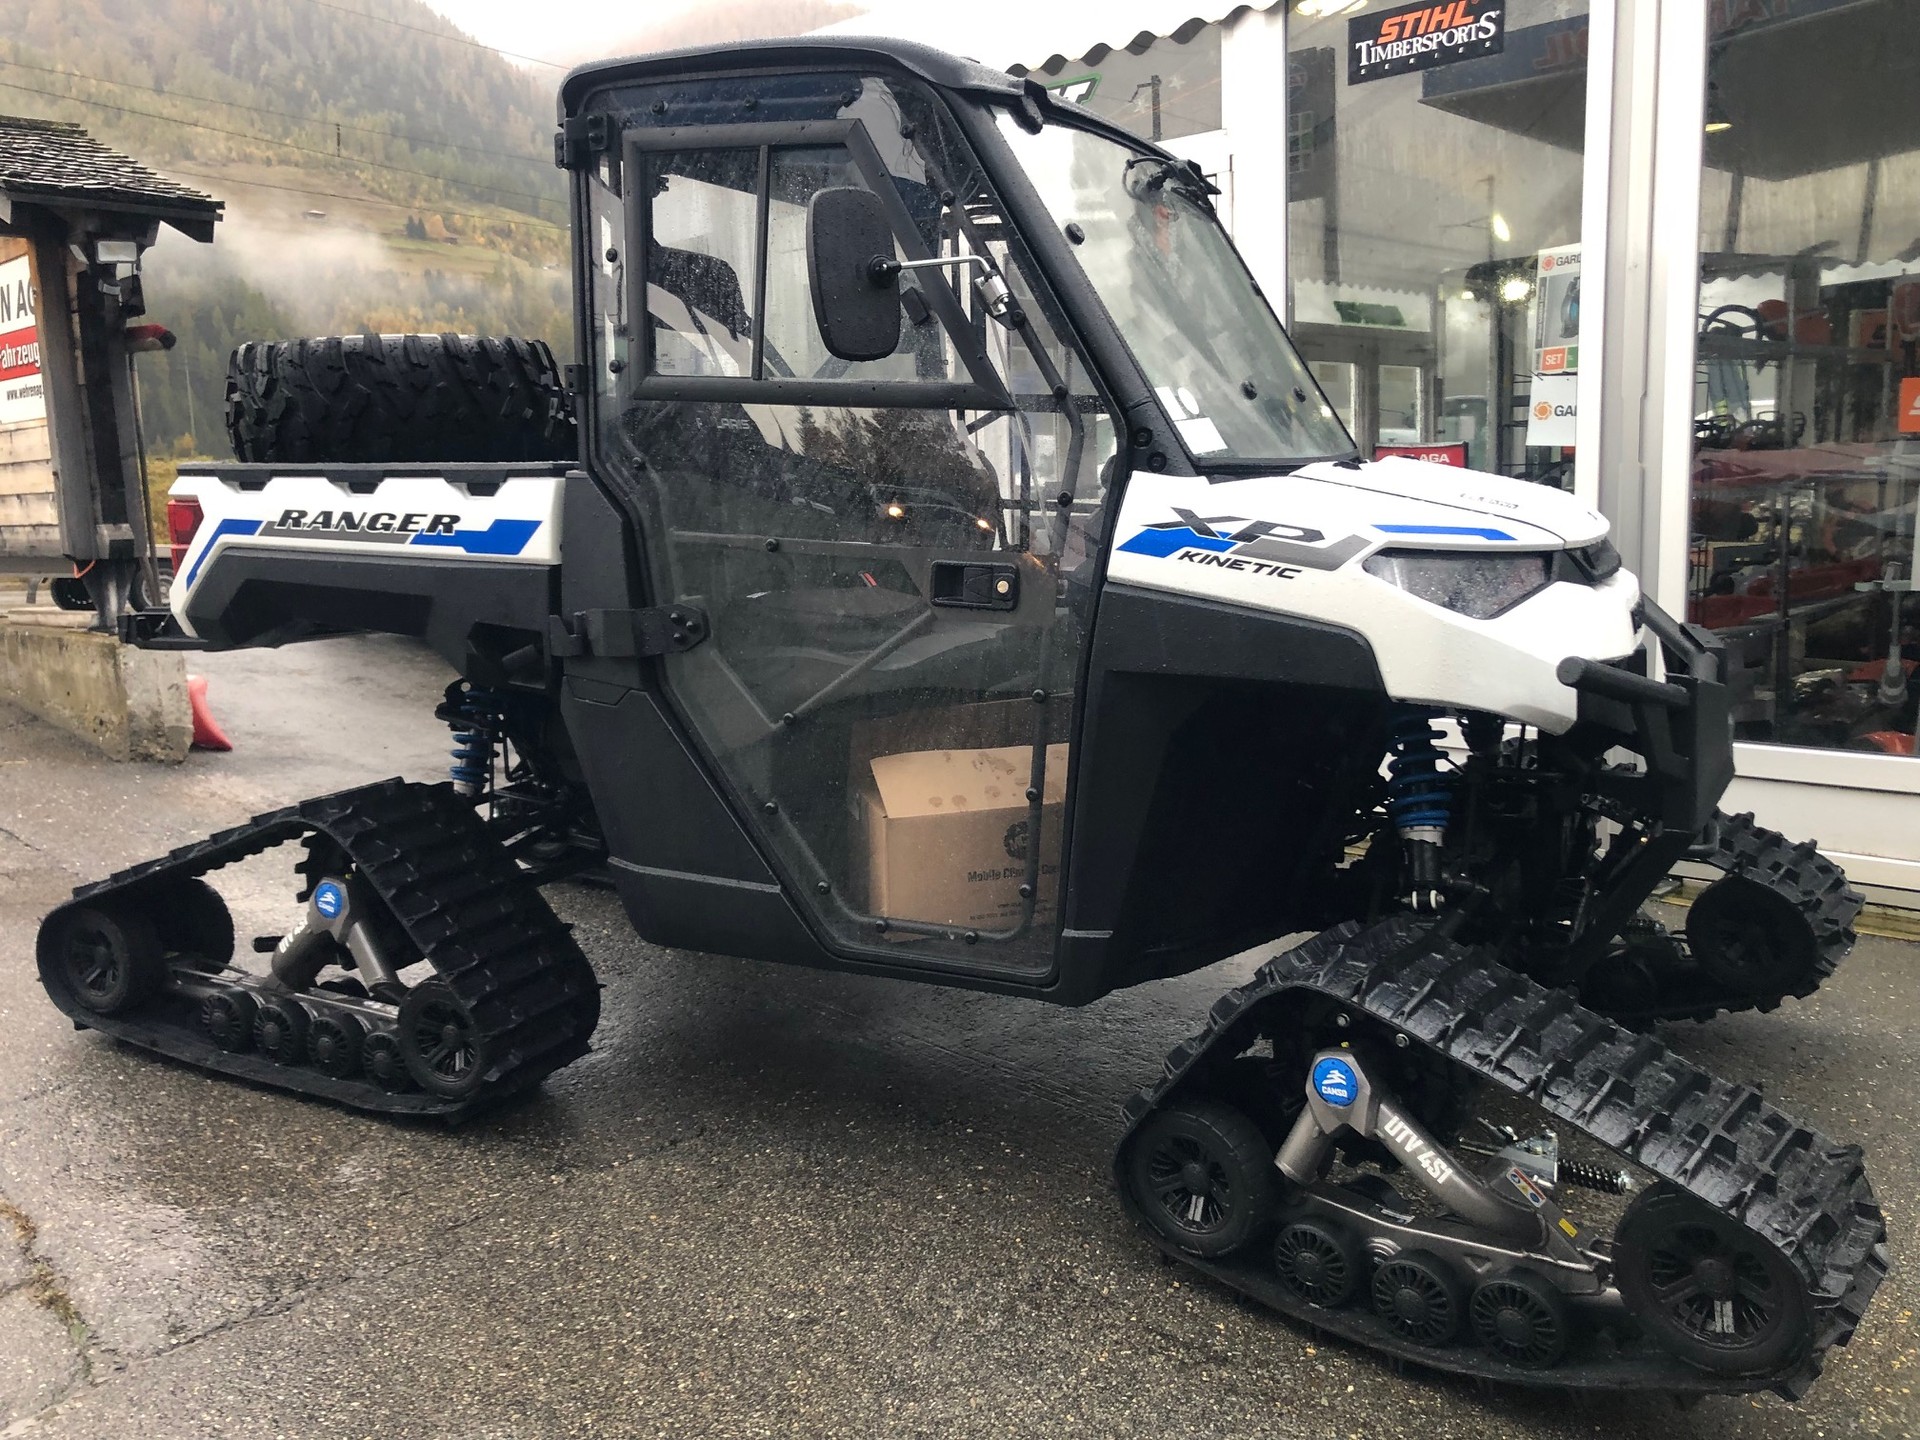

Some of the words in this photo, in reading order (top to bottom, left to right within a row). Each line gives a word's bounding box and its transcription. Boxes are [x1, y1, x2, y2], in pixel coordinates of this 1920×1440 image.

[1377, 0, 1475, 44] STIHL
[1360, 41, 1492, 75] SERIES
[0, 343, 40, 369] ahrzeug
[1545, 354, 1563, 366] SET
[1554, 405, 1577, 417] GA
[275, 509, 461, 534] RANGER
[1140, 507, 1325, 543] XP
[1178, 551, 1302, 580] KINETIC
[967, 869, 1001, 883] Mobile
[1321, 1085, 1348, 1098] CAMSO
[1384, 1115, 1424, 1152] UTV
[1417, 1150, 1453, 1184] 4S1
